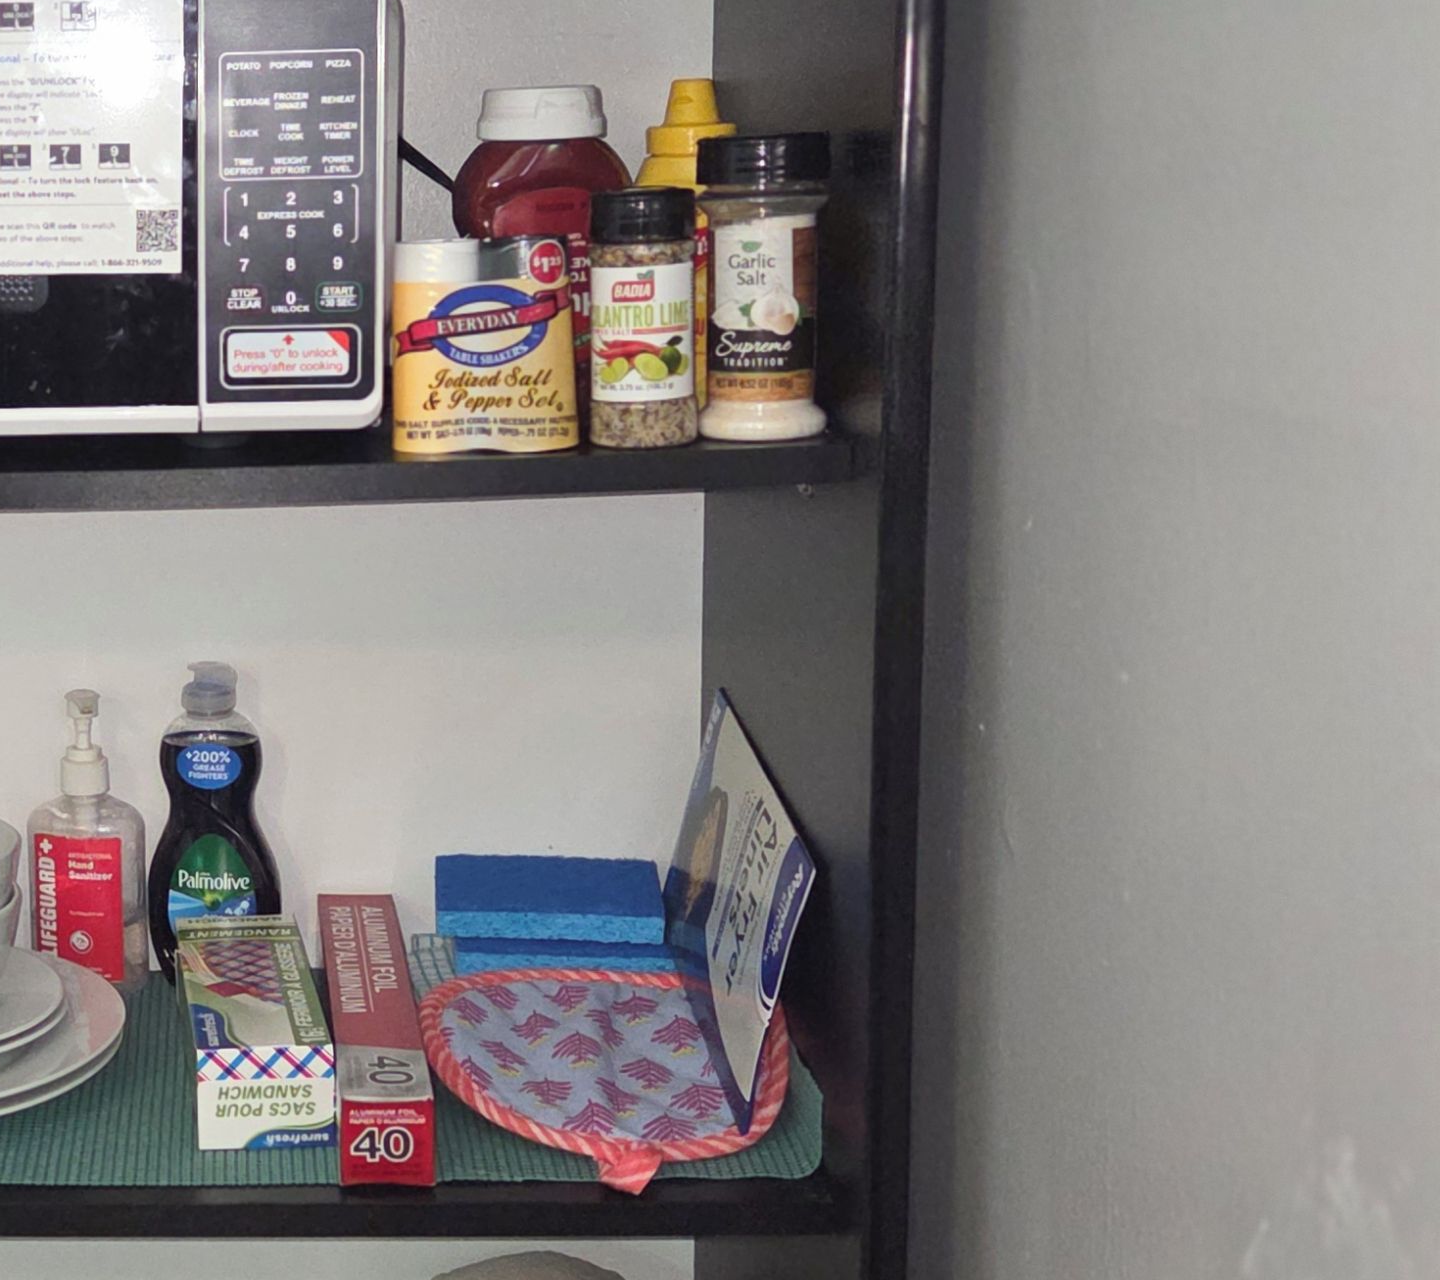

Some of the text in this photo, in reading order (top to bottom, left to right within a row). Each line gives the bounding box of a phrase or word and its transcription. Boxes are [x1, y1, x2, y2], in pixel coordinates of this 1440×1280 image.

[226, 61, 261, 71] POTATO
[269, 60, 313, 69] POPCORN
[325, 59, 352, 68] PIZZA
[223, 97, 270, 107] BEVERAGE
[273, 91, 309, 100] FROZEN
[320, 94, 356, 104] REHEAT
[274, 100, 308, 111] DINNER
[280, 122, 301, 131] TIME
[319, 121, 358, 130] KITCHEN
[228, 129, 259, 138] CLOCK
[278, 132, 304, 141] COOK
[324, 130, 352, 140] TIMER
[233, 157, 254, 166] TIME
[273, 155, 308, 164] WEIGHT
[321, 154, 354, 163] POWER
[223, 165, 264, 176] DEFROST
[270, 164, 312, 175] DEFROST
[324, 164, 352, 174] LEVEL
[240, 192, 249, 207] 1
[285, 191, 297, 206] 2
[333, 189, 344, 205] 3
[256, 209, 326, 220] EXPRESS COOK
[42, 221, 56, 230] QR
[58, 221, 77, 230] code
[238, 224, 250, 240] 4
[285, 224, 297, 239] 5
[332, 222, 344, 238] 6
[238, 257, 250, 273] 7
[285, 257, 297, 272] 8
[332, 255, 344, 271] 9
[728, 254, 776, 270] Garlic
[736, 271, 766, 286] Salt
[230, 287, 259, 298] STOP
[322, 285, 356, 296] START
[612, 283, 652, 300] BADIA
[226, 299, 262, 310] CLEAR
[285, 290, 297, 306] 0
[271, 304, 310, 314] UNLOCK
[660, 300, 689, 326] LIME
[437, 310, 520, 336] EVERYDAY
[715, 330, 792, 358] Supreme
[233, 349, 266, 360] Press
[287, 348, 299, 359] to
[301, 346, 338, 359] unlock
[449, 343, 530, 365] TABLE SHAKERS
[232, 360, 344, 374] during/after cooking
[723, 357, 785, 368] TRADITION
[428, 368, 502, 391] Iodized
[422, 391, 441, 412] &
[446, 388, 514, 414] Pepper
[192, 763, 226, 772] GREASE
[188, 771, 229, 781] FIGHTERS
[758, 822, 778, 883] Air
[68, 860, 94, 870] Hand
[729, 807, 771, 928] Liners
[68, 870, 113, 881] Sanitizer
[178, 869, 250, 891] Palmolive
[38, 856, 58, 957] LIFEGUARD
[186, 928, 292, 939] RANGEMENT
[361, 904, 398, 994] ALUMINUM FOIL
[726, 891, 758, 997] Fryer
[329, 906, 368, 1014] PAPIER D'ALUMINIUM
[367, 1055, 414, 1084] 40
[217, 1084, 313, 1100] SANDWICH
[215, 1101, 317, 1118] SACS POUR
[266, 1133, 329, 1147] surefresh
[349, 1126, 414, 1162] 40
